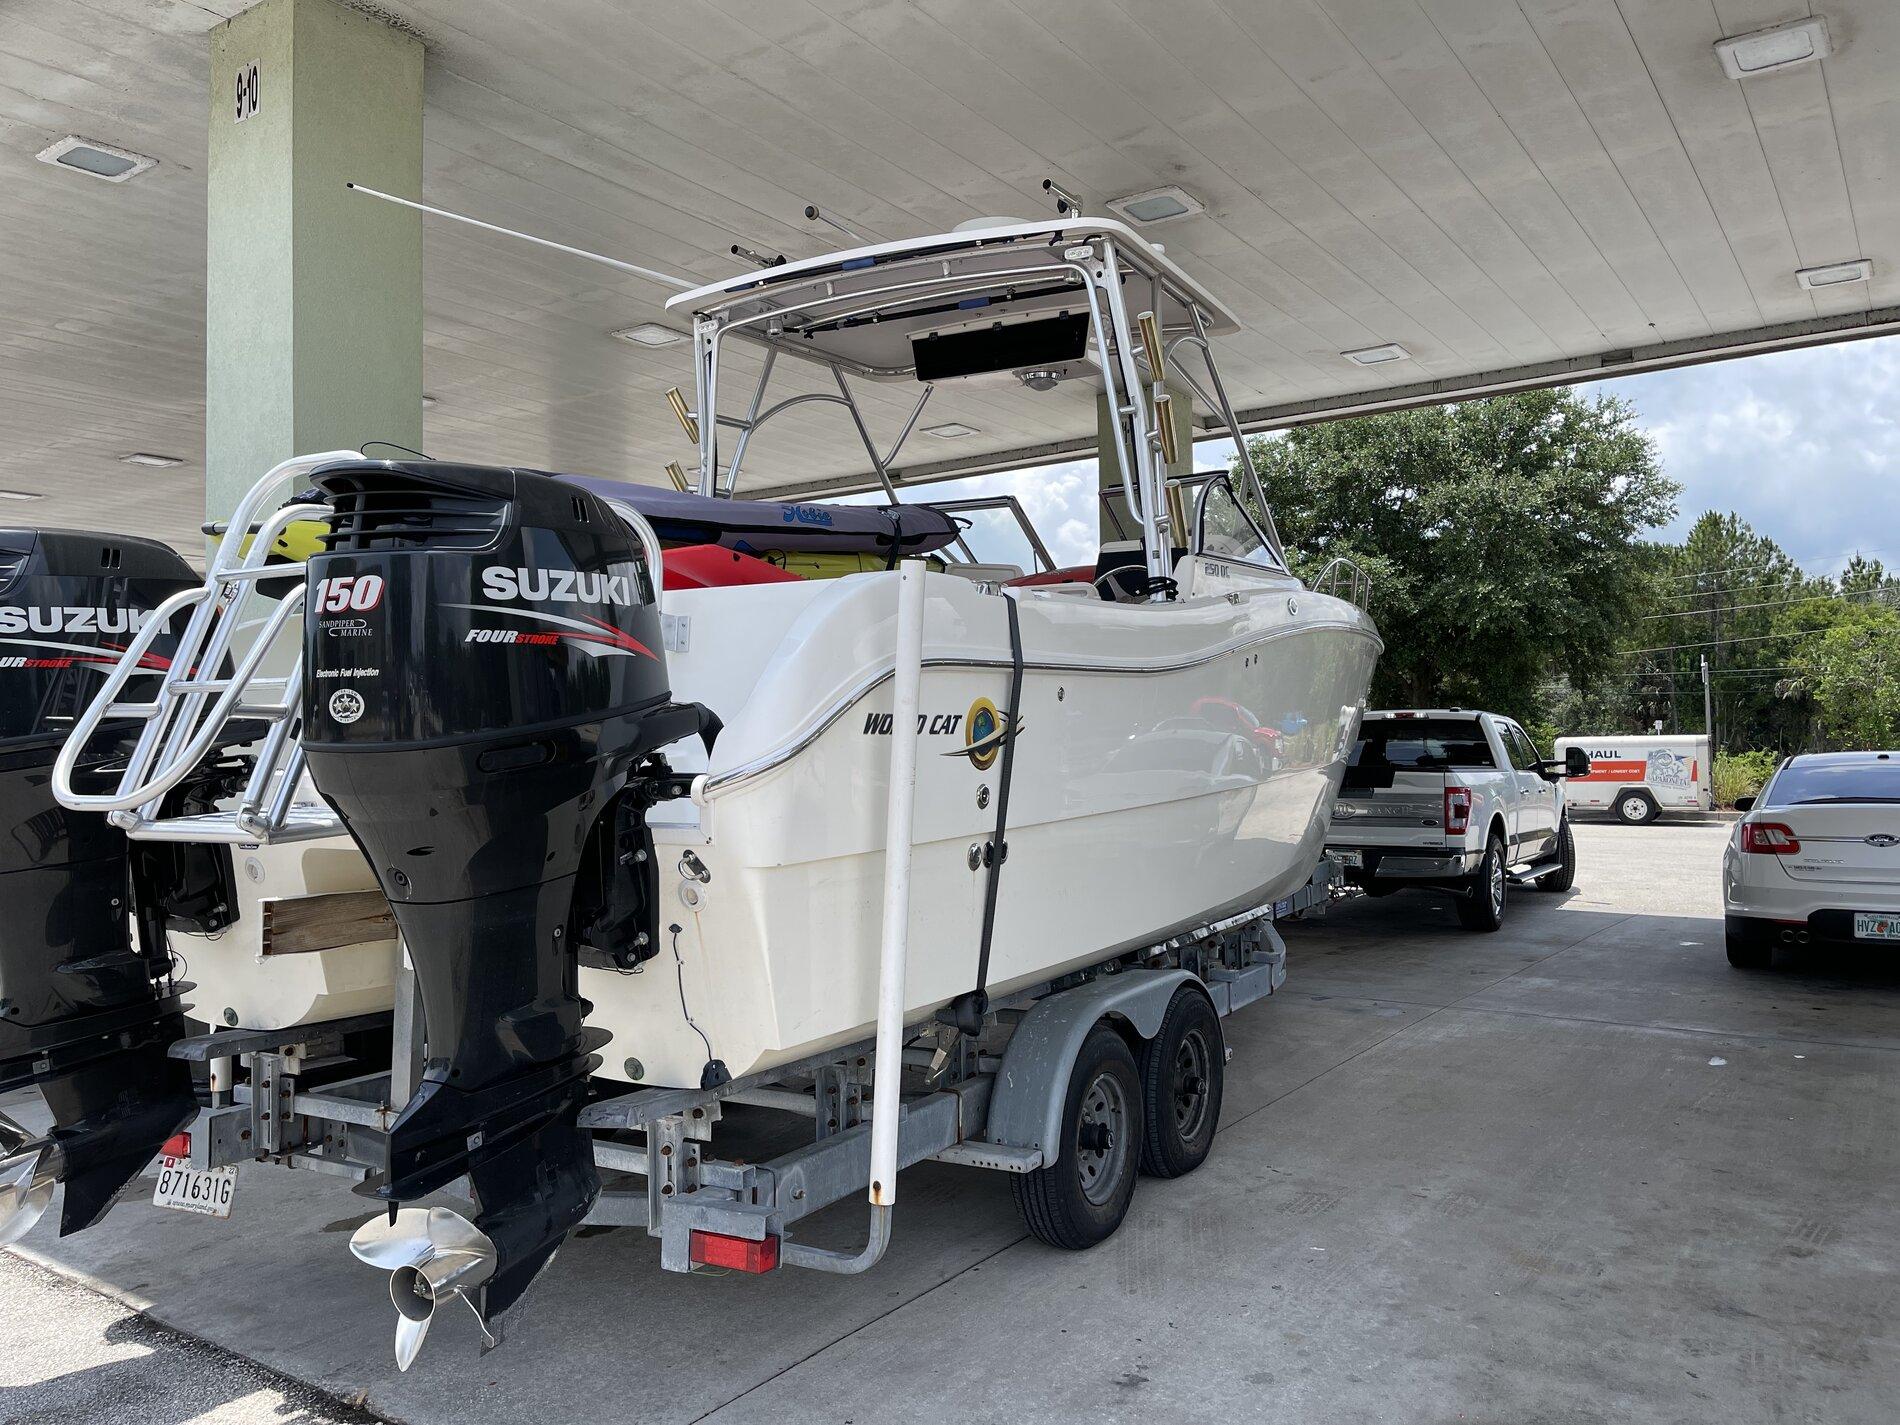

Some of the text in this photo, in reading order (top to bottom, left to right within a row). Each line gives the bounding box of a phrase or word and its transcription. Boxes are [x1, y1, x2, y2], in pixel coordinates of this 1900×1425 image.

[236, 65, 258, 119] 9-10
[782, 505, 832, 527] Hobie
[314, 574, 385, 614] 150
[481, 565, 631, 607] SUZUKI
[319, 619, 355, 628] SANDPIPER
[340, 628, 373, 637] MARINE
[315, 667, 380, 678] Electronic Fuel Injection
[862, 712, 963, 735] WOD CAT
[1589, 750, 1622, 759] HAUL
[1856, 919, 1877, 932] HVZ
[159, 1170, 231, 1205] 871631G
